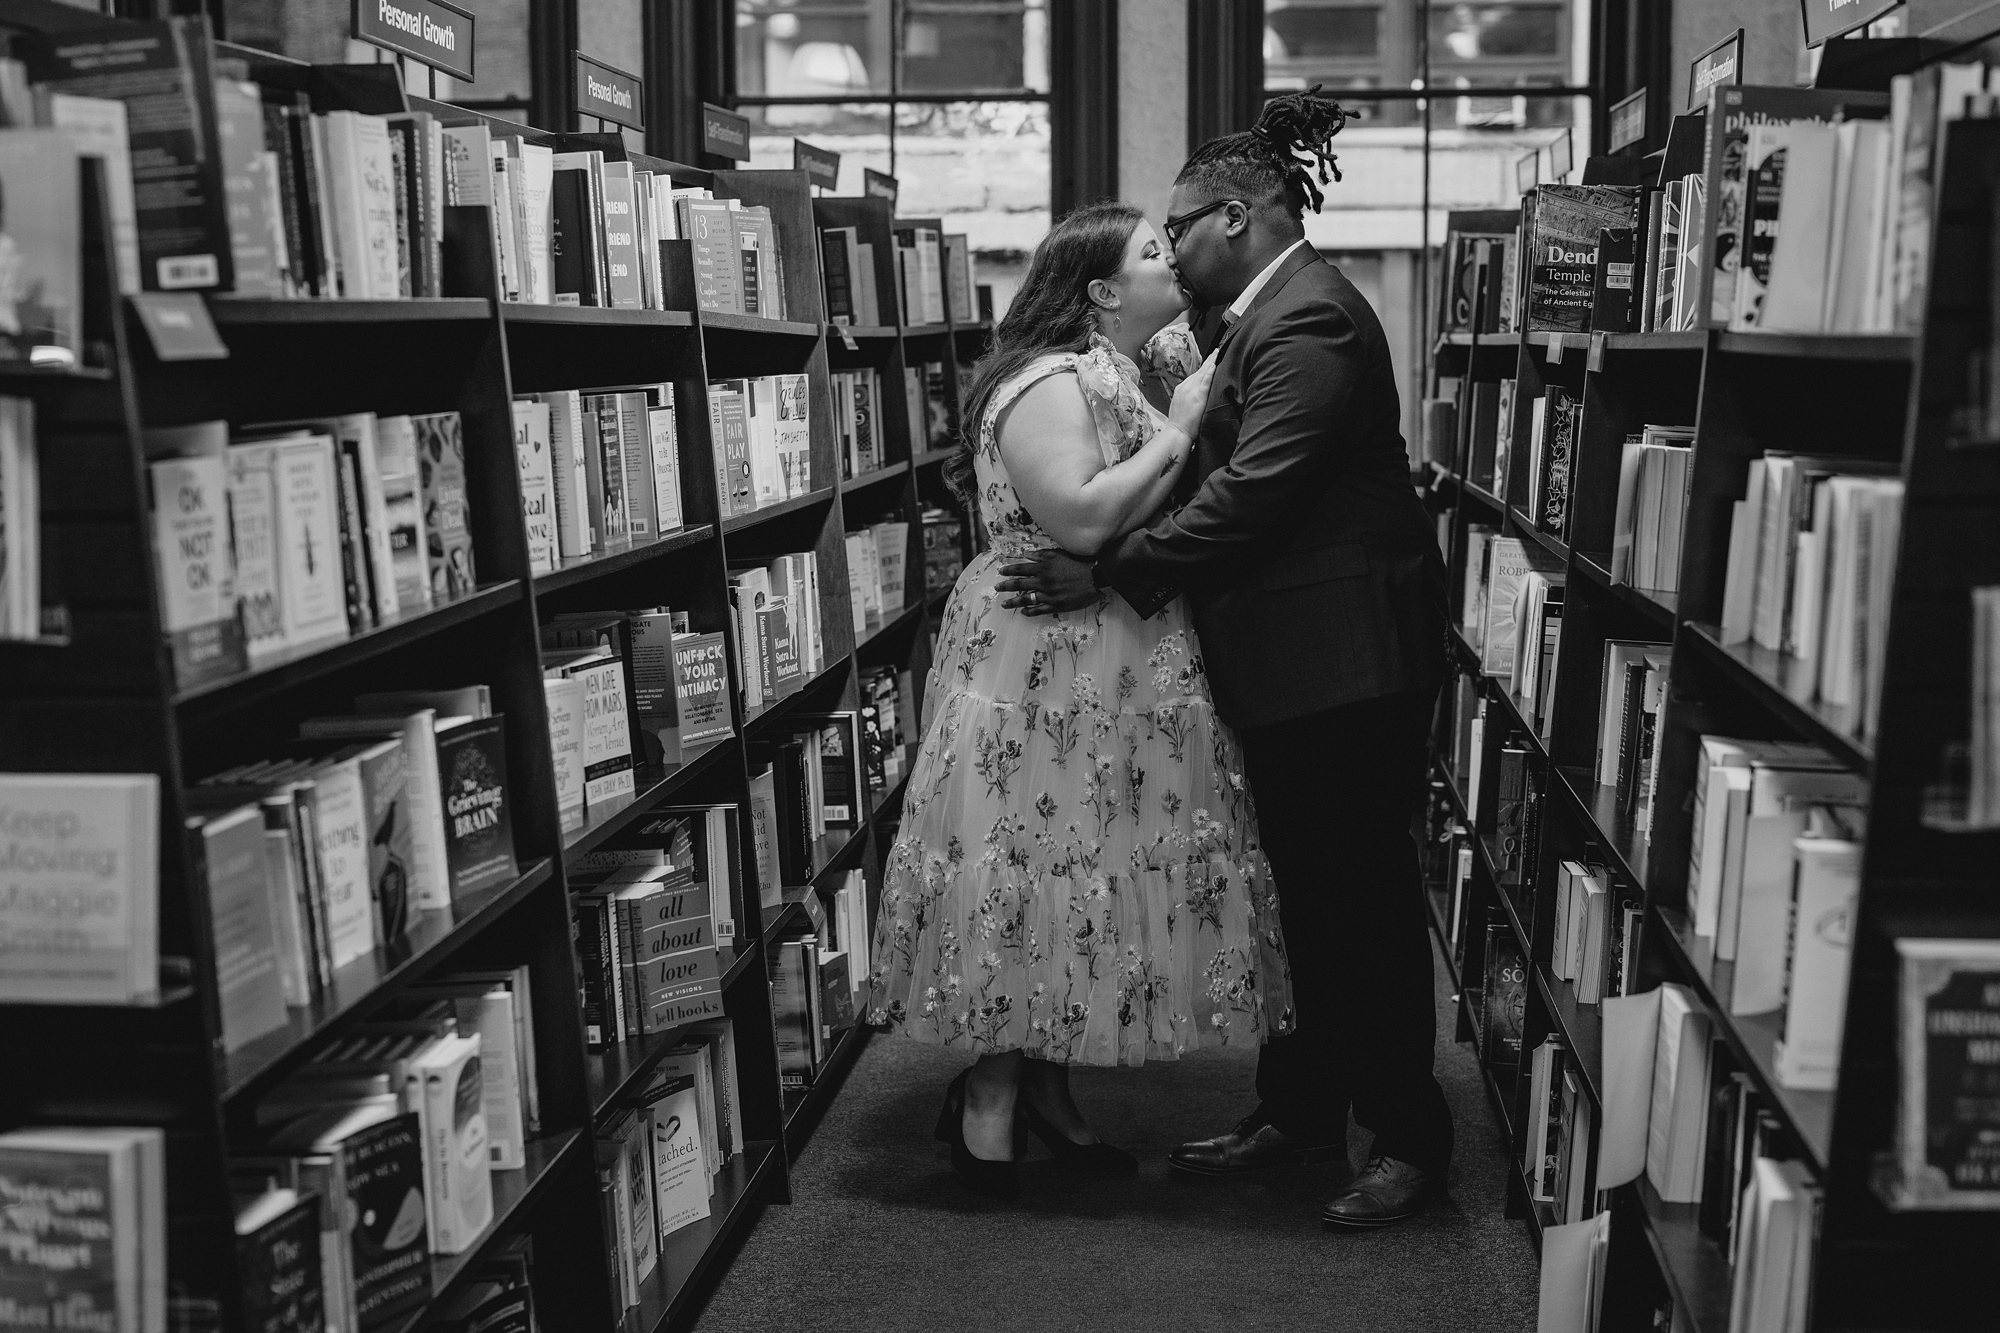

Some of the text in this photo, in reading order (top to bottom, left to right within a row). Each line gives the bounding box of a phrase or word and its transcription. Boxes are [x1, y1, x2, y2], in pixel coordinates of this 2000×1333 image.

[379, 0, 454, 51] Personal Growth
[588, 75, 632, 109] Personal Growth
[694, 214, 708, 240] 13
[1548, 246, 1599, 265] Dend
[1546, 268, 1591, 284] Temple
[1545, 288, 1591, 297] The Celestial
[1553, 299, 1581, 307] Ancient
[788, 386, 806, 400] RULES
[712, 402, 723, 451] FAIR PLAY
[726, 422, 744, 440] FAIR
[727, 442, 745, 460] PLAY
[775, 637, 789, 650] Kama
[675, 644, 724, 666] UNF#CK
[775, 652, 789, 664] Sutra
[602, 669, 617, 691] ARE
[683, 662, 717, 681] YOUR
[763, 656, 771, 686] Workout
[776, 662, 799, 677] Workout
[677, 676, 727, 699] INTIMACY
[602, 691, 626, 714] MARS,
[455, 807, 499, 838] BRAIN
[674, 886, 700, 895] BESTSELLER
[659, 894, 684, 920] all
[652, 926, 702, 954] about
[661, 961, 698, 983] love
[661, 985, 703, 999] NEW VISIONS
[655, 1000, 719, 1026] bell hooks
